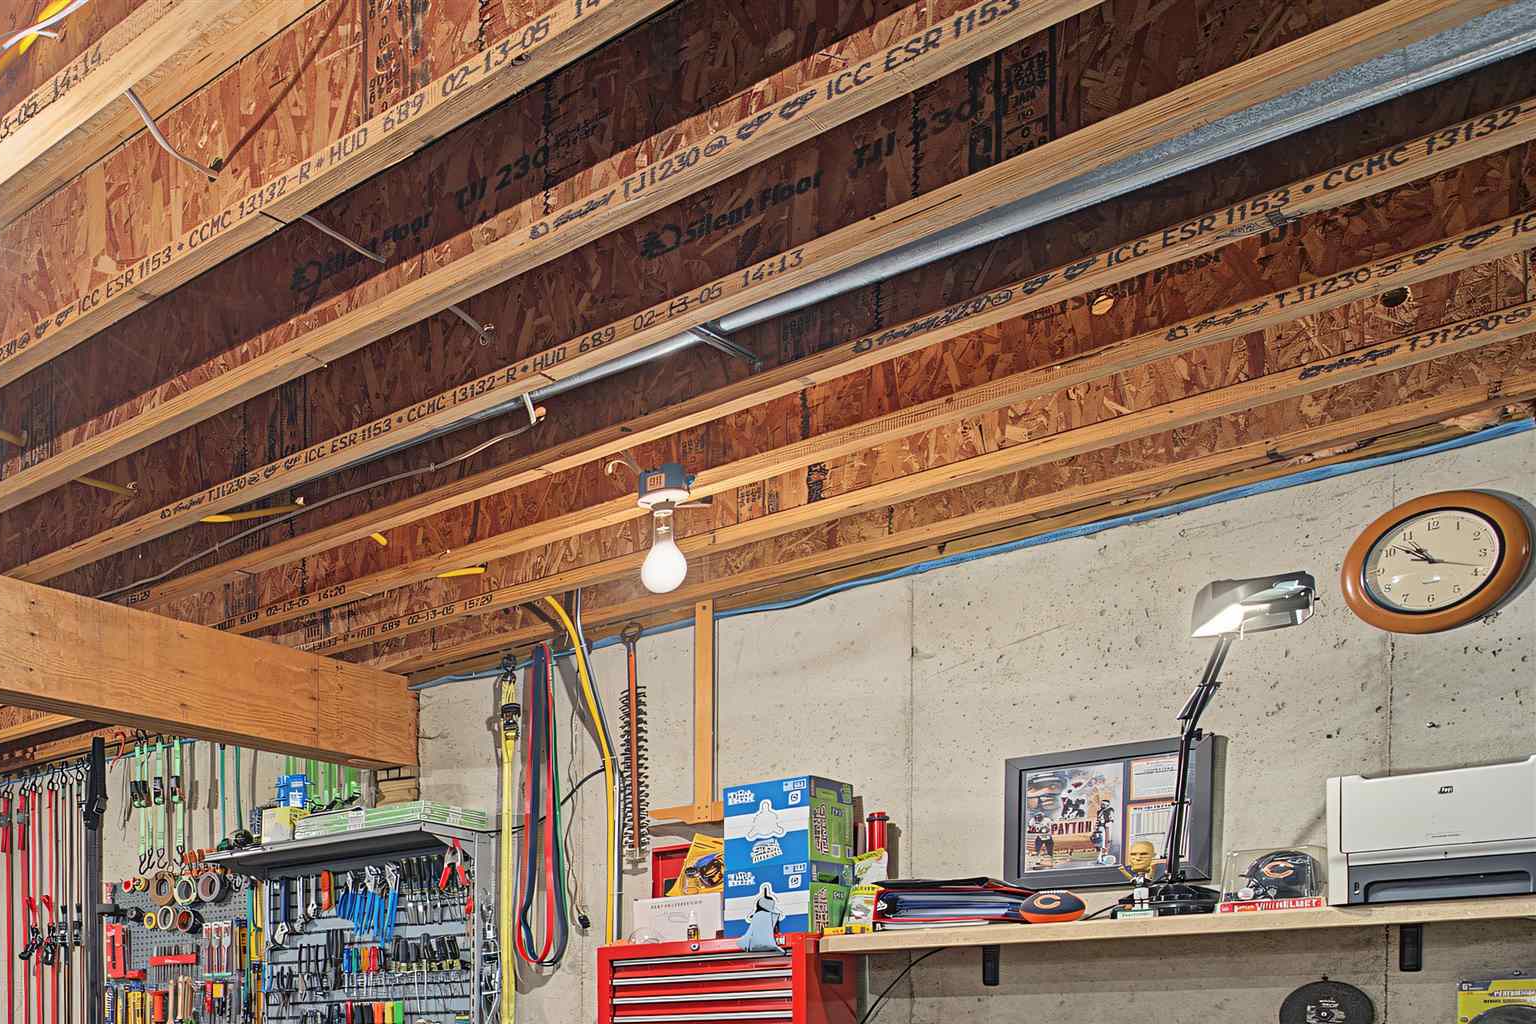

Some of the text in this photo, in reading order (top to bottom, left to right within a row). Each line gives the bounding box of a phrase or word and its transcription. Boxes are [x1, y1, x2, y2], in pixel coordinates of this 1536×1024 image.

[825, 63, 872, 100] ICC
[883, 27, 943, 73] ESR
[1106, 239, 1149, 268] ICC
[1161, 216, 1216, 247] ESR
[1225, 188, 1290, 227] 1153
[78, 290, 100, 315] ICC
[106, 268, 134, 299] ESR
[139, 246, 172, 279] 1153
[188, 209, 232, 248] CCMC
[239, 161, 312, 219] 13132-R
[331, 433, 357, 453] ESR
[451, 367, 517, 405] 13132-R
[1427, 520, 1440, 532] 12
[1456, 520, 1461, 531] 1
[1402, 530, 1414, 542] 11
[1383, 548, 1397, 558] 10
[1051, 821, 1092, 835] PAYTON
